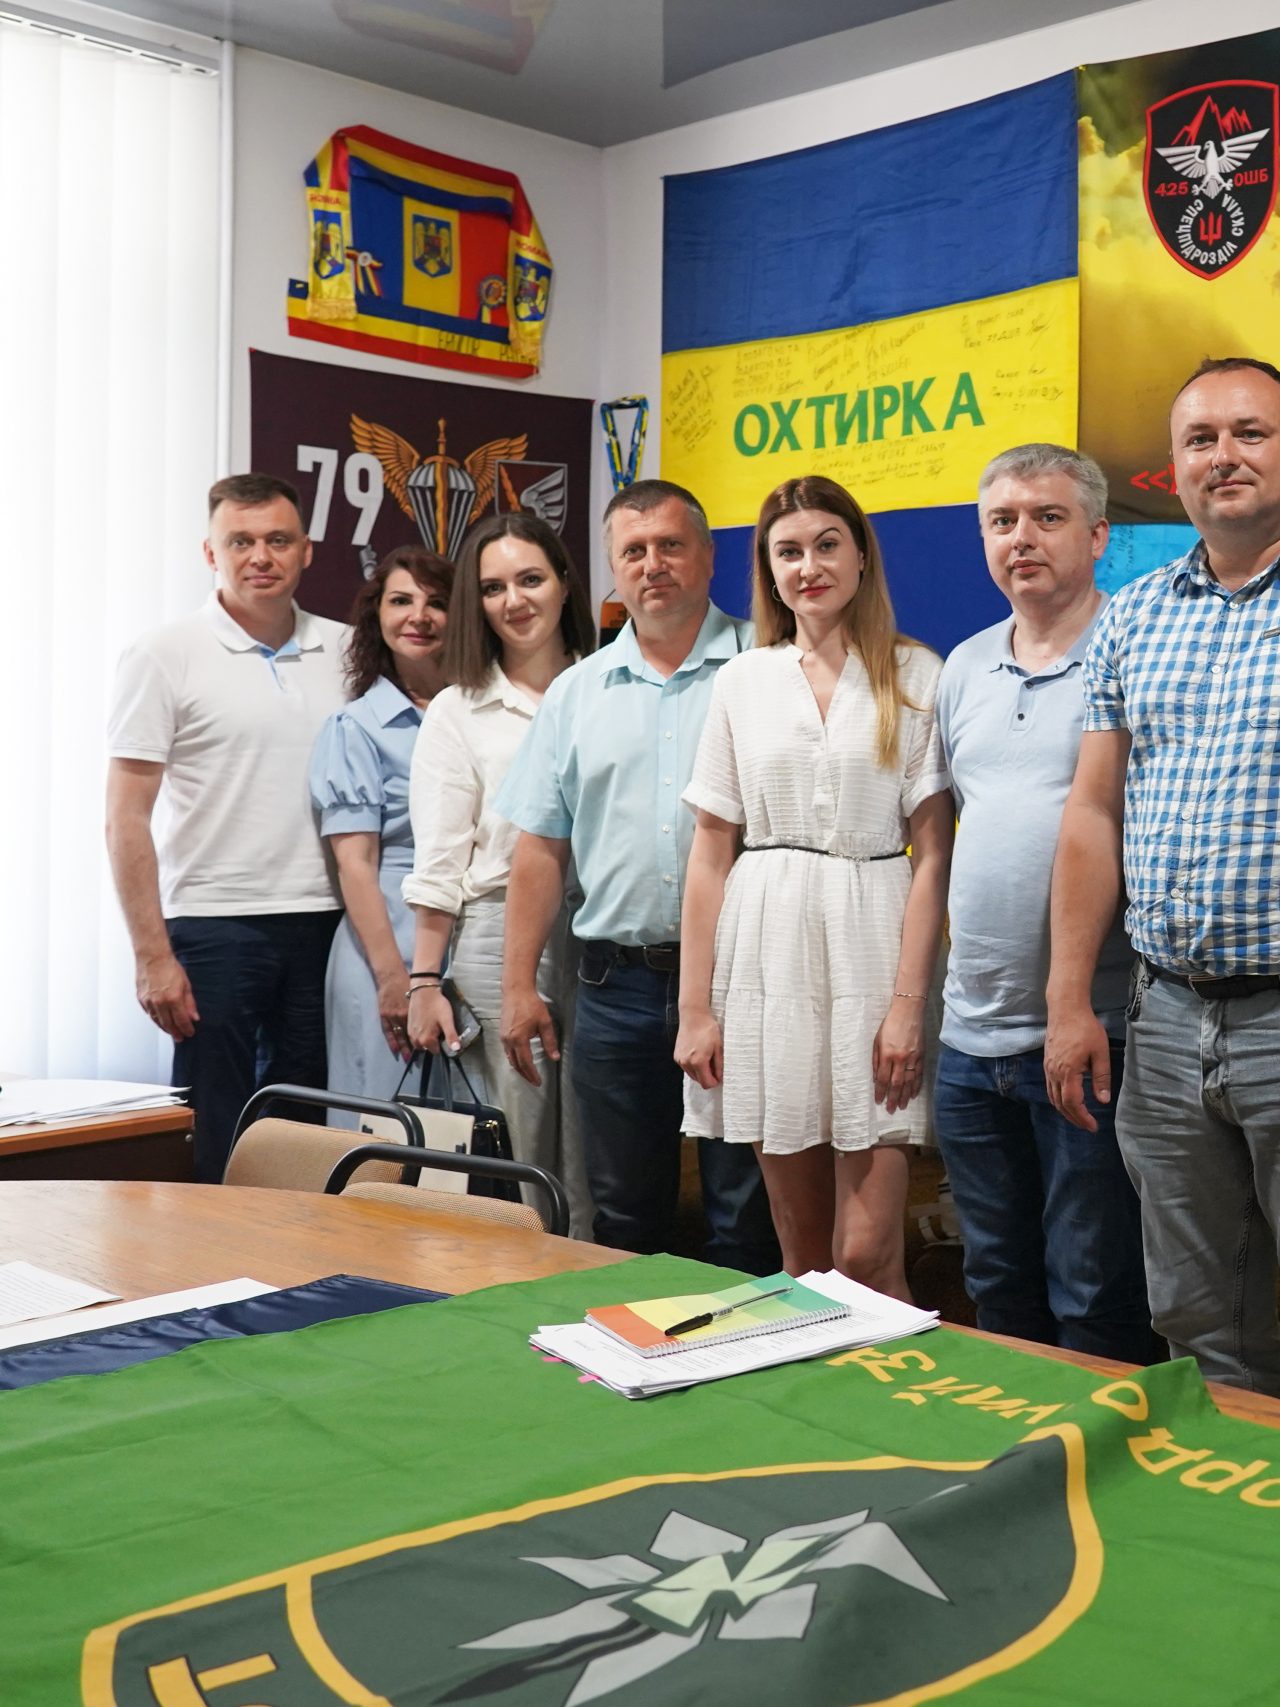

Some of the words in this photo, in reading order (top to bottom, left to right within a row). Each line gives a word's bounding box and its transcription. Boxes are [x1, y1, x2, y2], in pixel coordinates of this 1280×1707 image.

[1154, 182, 1190, 201] 425
[1233, 168, 1270, 188] ОШБ
[733, 371, 986, 458] ОХТИРКА
[296, 444, 385, 548] 79
